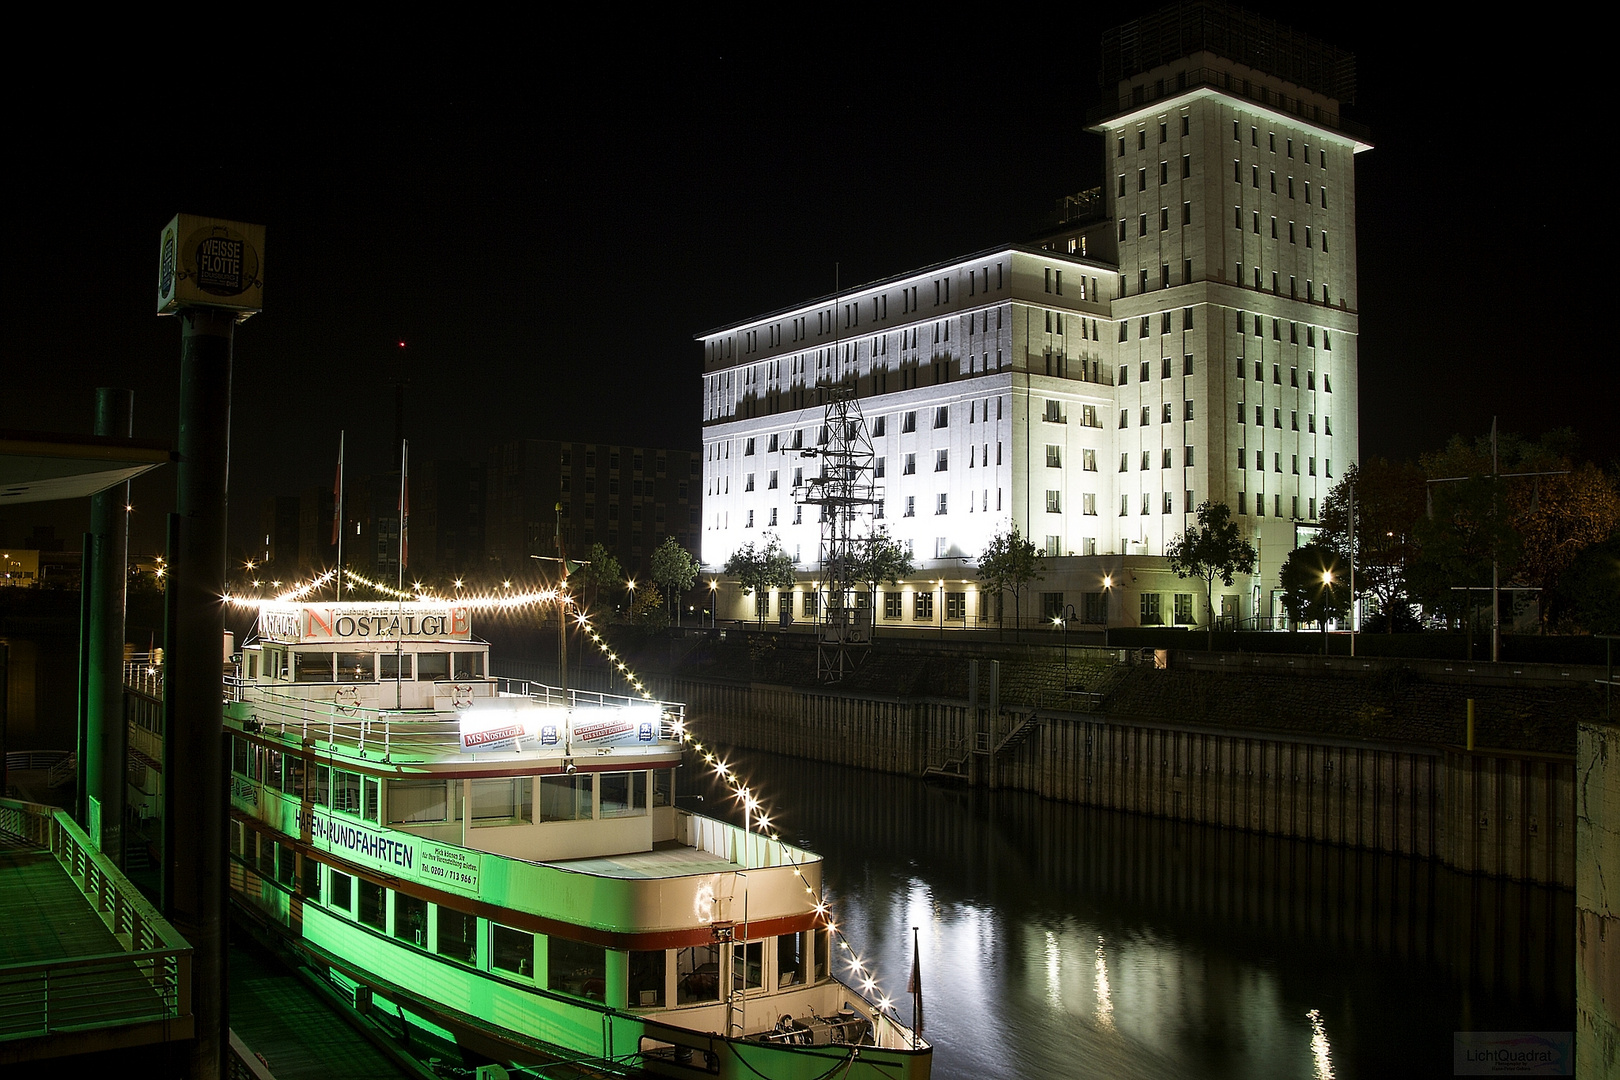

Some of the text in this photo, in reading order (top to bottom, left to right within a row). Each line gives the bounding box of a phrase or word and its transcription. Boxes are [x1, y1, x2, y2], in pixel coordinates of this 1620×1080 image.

[202, 239, 241, 259] WEISSE
[201, 255, 240, 275] FLOTTE
[305, 606, 470, 638] NOSTALGIE
[467, 732, 482, 745] MS
[482, 725, 524, 743] NOSTALGIE
[294, 808, 413, 869] HAFEN-RUNDFAHRTEN
[421, 863, 430, 873] Tel.
[430, 866, 444, 877] 0203
[449, 870, 460, 881] 713
